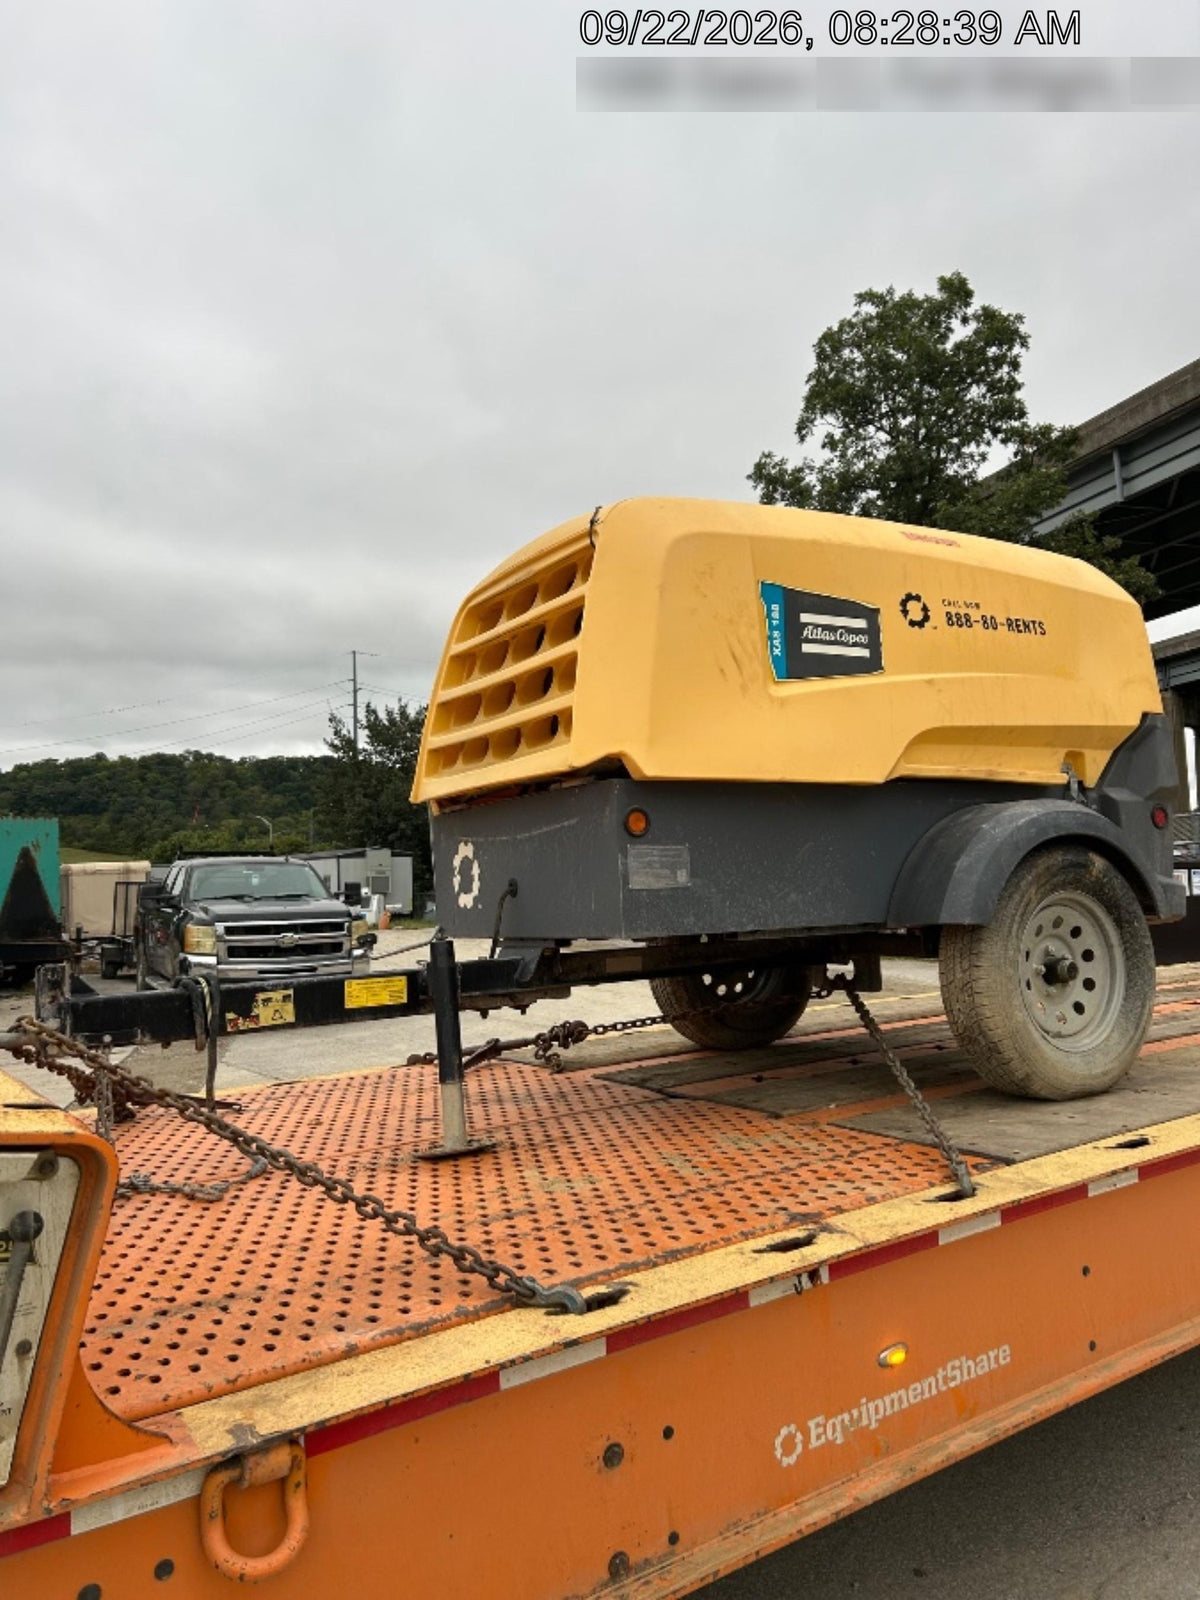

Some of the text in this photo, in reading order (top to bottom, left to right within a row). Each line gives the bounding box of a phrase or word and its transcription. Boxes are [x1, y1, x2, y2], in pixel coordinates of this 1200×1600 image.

[801, 625, 869, 645] Atlas Copco
[945, 610, 1047, 636] 888-80-RENTS
[808, 1343, 1011, 1450] EquipmentShare
